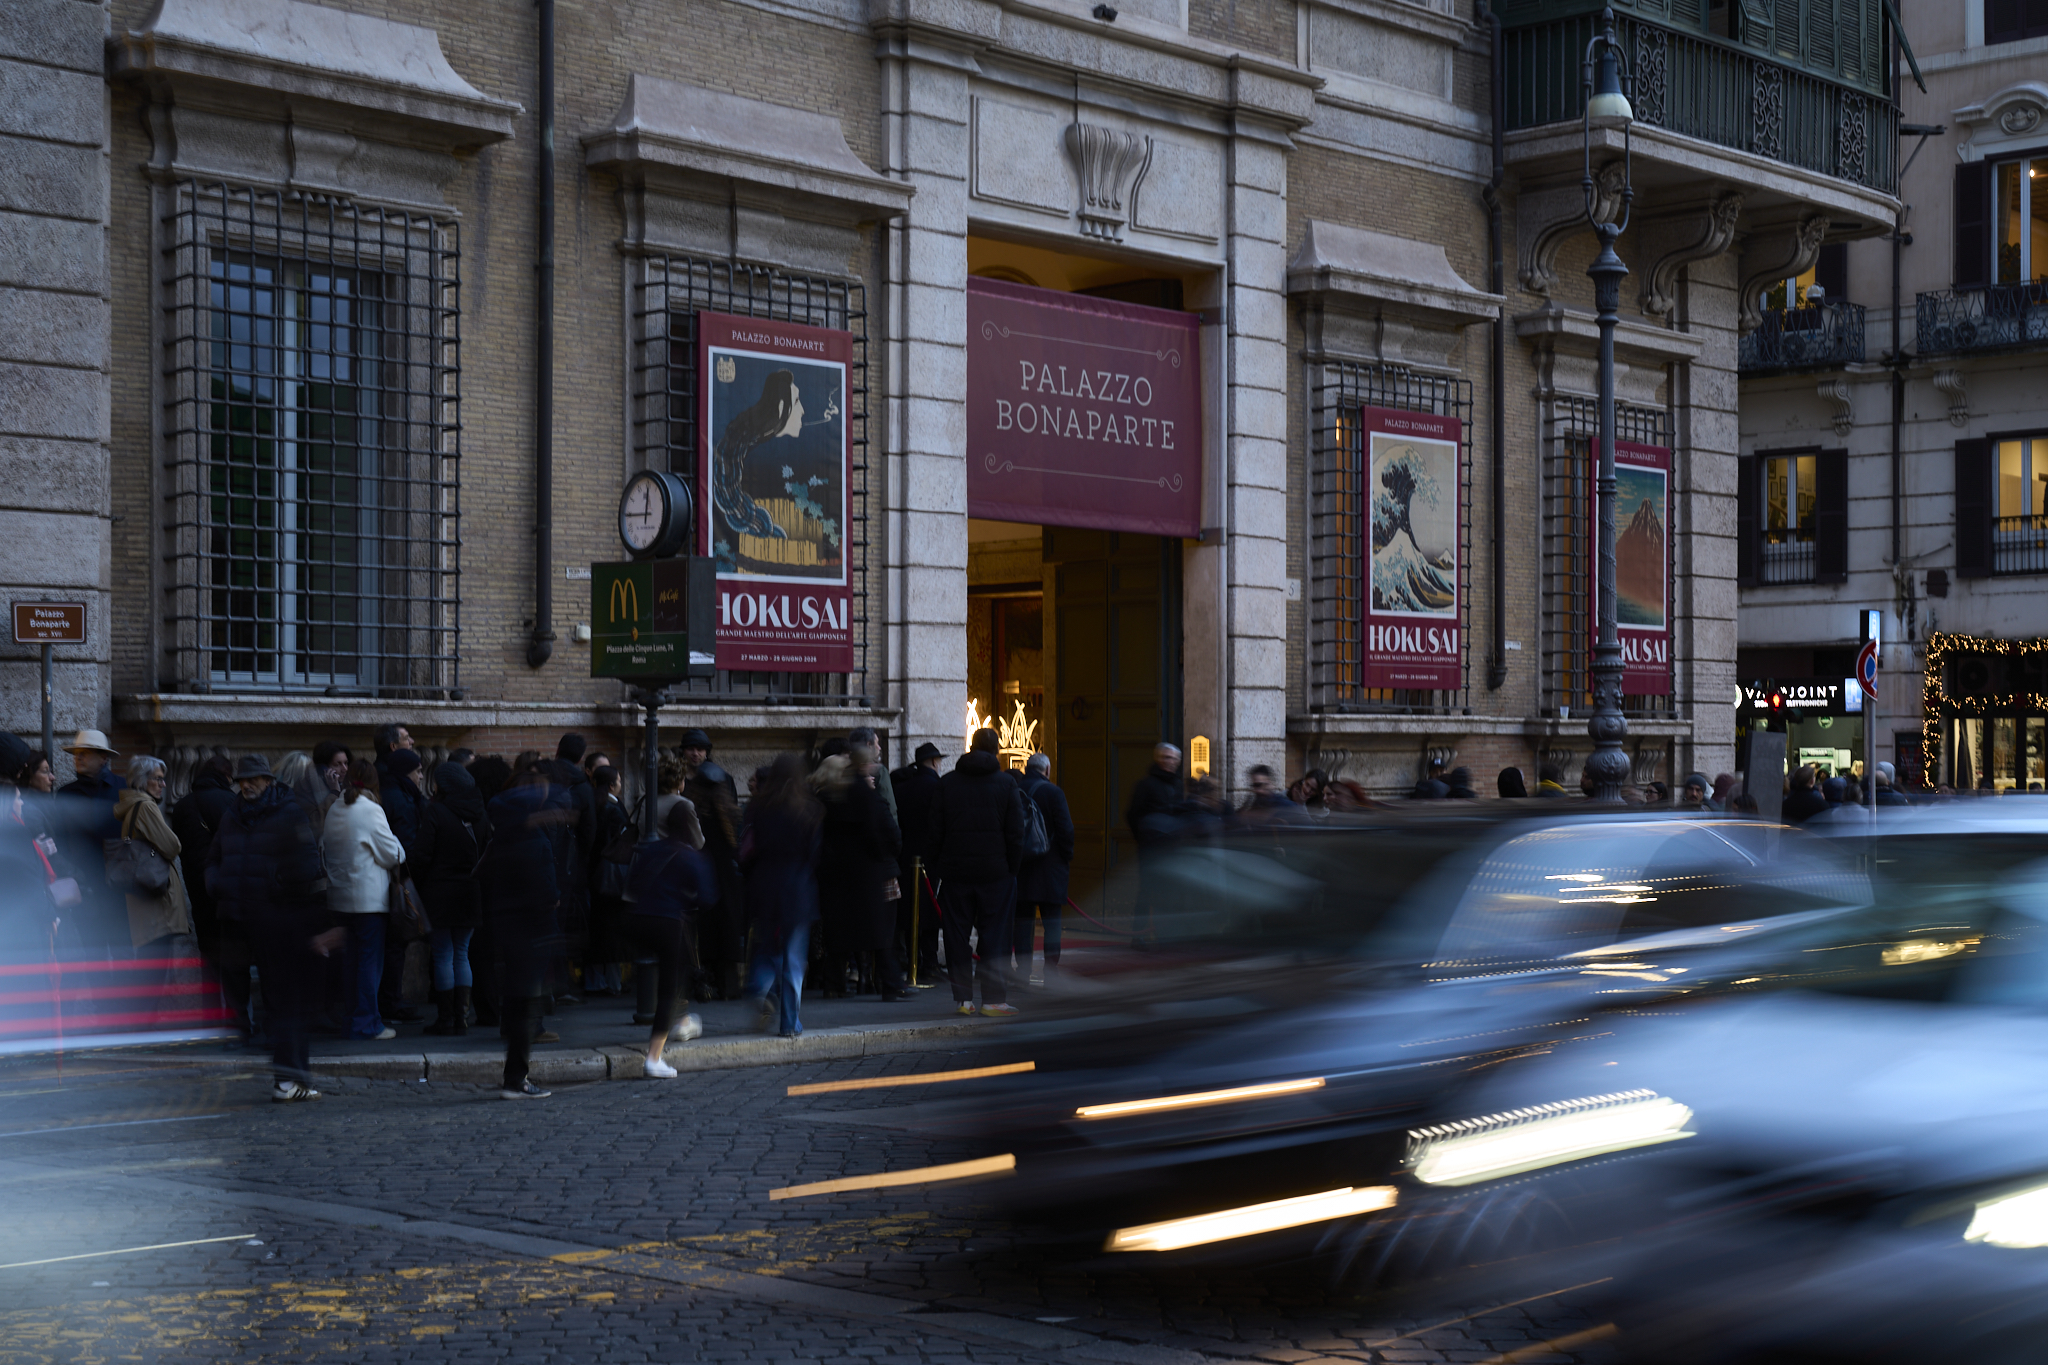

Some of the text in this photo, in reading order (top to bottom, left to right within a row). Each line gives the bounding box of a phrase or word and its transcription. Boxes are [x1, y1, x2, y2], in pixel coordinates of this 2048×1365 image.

[731, 330, 825, 352] PALAZZO BONAPARTE
[1020, 360, 1152, 406] PALAZZO
[996, 399, 1175, 450] BONAPARTE
[1384, 418, 1444, 434] PALAZZO BONAPARTE
[1630, 451, 1657, 463] BONAPARTE
[35, 608, 65, 618] Palazzo
[29, 618, 70, 629] Bonaparte
[716, 629, 847, 641] GRANDE MAESTRO DELL'ARTE GIAPPONESE
[1369, 624, 1458, 655] HOKUSAI
[606, 644, 622, 654] Piazza
[1596, 635, 1667, 664] KUSAI
[632, 655, 647, 665] Roma
[748, 653, 769, 662] MARZO
[781, 654, 803, 663] GIUGNO
